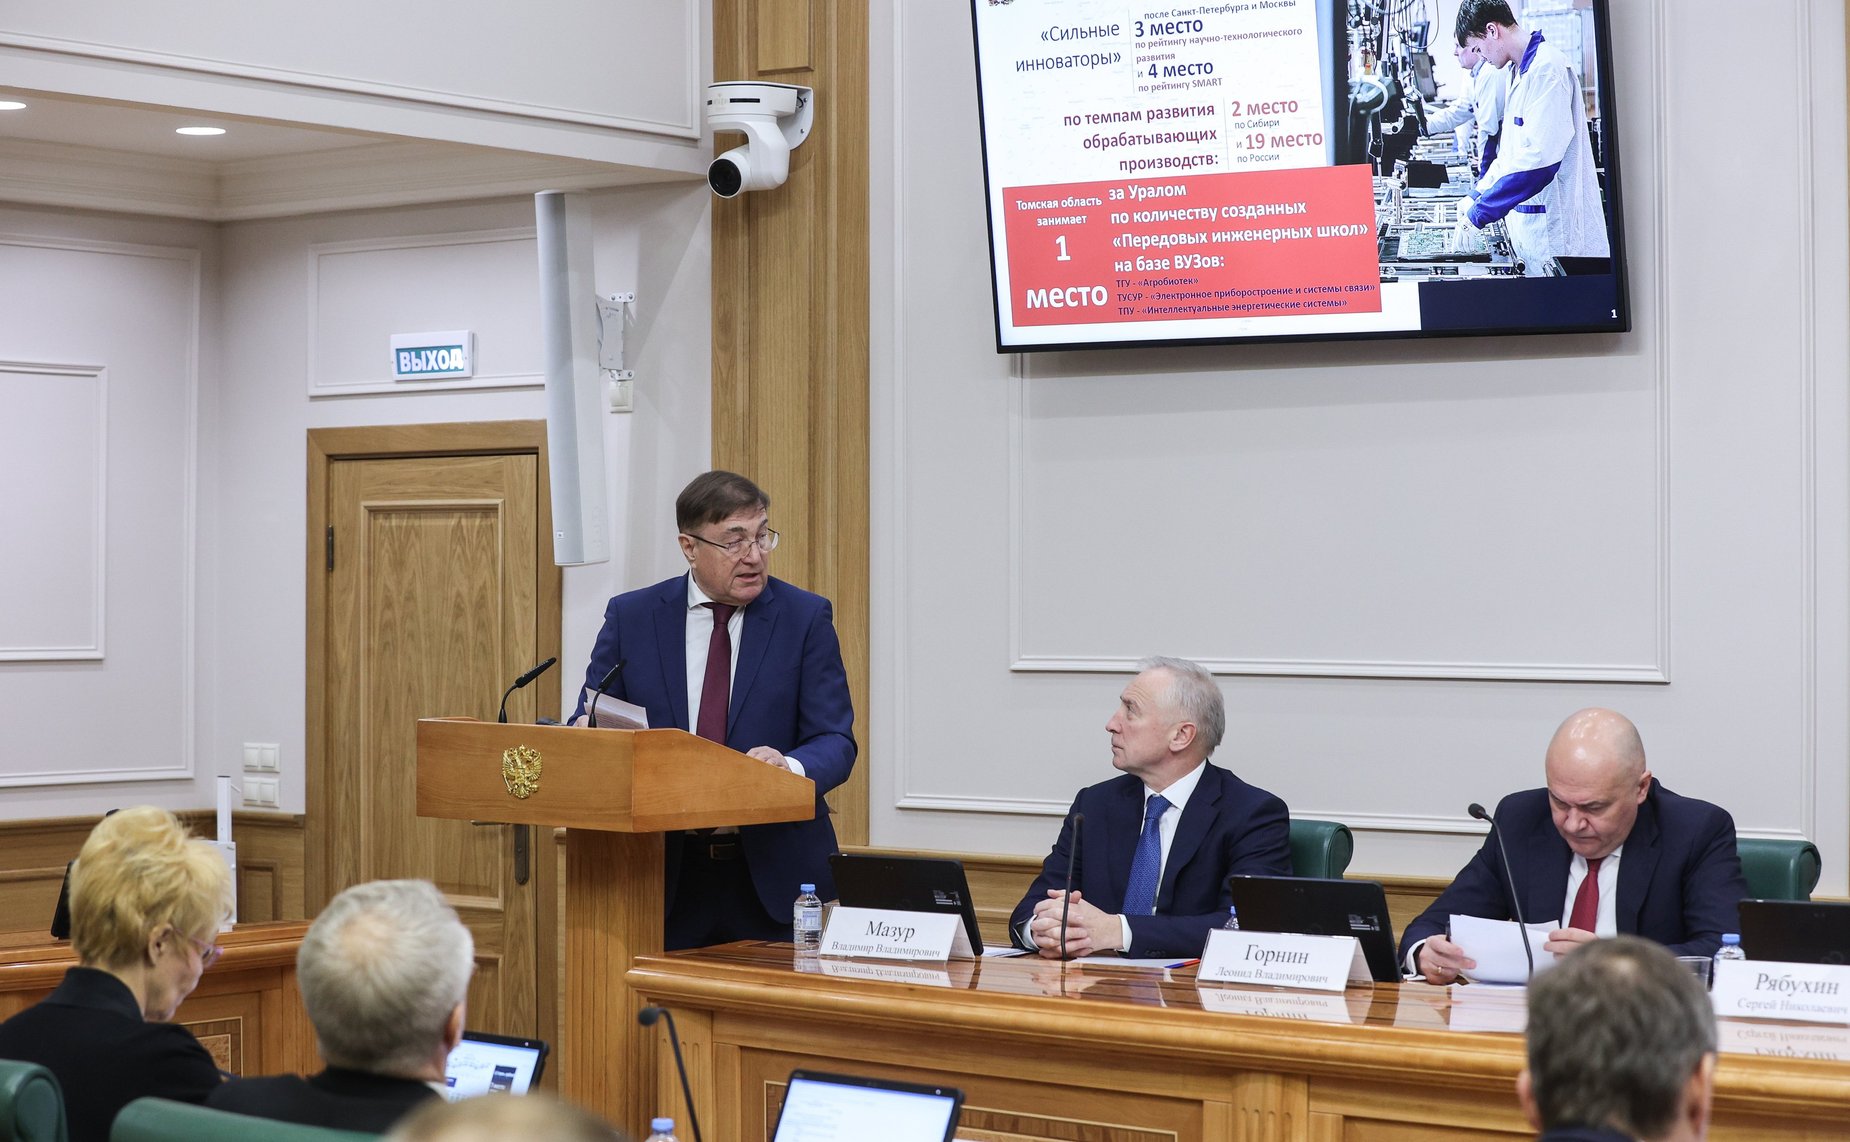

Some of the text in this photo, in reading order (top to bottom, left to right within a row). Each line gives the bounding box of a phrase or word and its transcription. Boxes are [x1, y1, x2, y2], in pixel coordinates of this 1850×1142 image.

[1144, 11, 1169, 20] после
[1171, 3, 1249, 18] Санкт-Петербурга
[1259, 0, 1296, 9] Москвы
[1040, 23, 1120, 42] «Сильные
[1134, 19, 1203, 38] 3 место
[1135, 28, 1303, 50] по рейтингу научно-технологического
[1016, 51, 1121, 72] инноваторы»
[1136, 53, 1176, 64] развития
[1148, 63, 1158, 78] 4
[1163, 62, 1214, 78] место
[1138, 78, 1223, 93] по рейтингу SMART
[1064, 105, 1215, 127] по темпам развития
[1232, 100, 1298, 117] 2 место
[1247, 118, 1280, 129] Сибири
[1083, 129, 1217, 151] обрабатывающих
[1246, 133, 1265, 150] 19
[1271, 133, 1323, 148] место
[1119, 154, 1219, 173] производств:
[1250, 154, 1280, 162] России
[1108, 184, 1187, 201] за Уралом
[1016, 196, 1103, 211] Томская область
[1037, 215, 1087, 227] занимает
[1110, 202, 1307, 224] по количеству созданных
[1113, 224, 1368, 249] «Передовых инженерных школ»
[1055, 235, 1071, 261] 1
[1115, 254, 1225, 272] на базе ВУЗов:
[1116, 280, 1131, 288] ТГУ
[1138, 277, 1199, 288] «Агробиотек»
[1026, 285, 1108, 309] место
[1117, 293, 1143, 302] ТУСУР
[1151, 291, 1212, 301] «Электронное
[1214, 287, 1293, 299] приборостроение
[1303, 285, 1342, 294] системы
[1344, 284, 1376, 292] связи»
[1118, 307, 1135, 316] ТПУ
[1142, 303, 1230, 315] «Интеллектуальные
[1231, 301, 1301, 313] энергетические
[1303, 299, 1348, 308] системы»
[1611, 309, 1618, 319] 1
[400, 348, 464, 372] ВЫХОД
[865, 920, 915, 942] Мазур
[831, 941, 940, 958] Владимир Владимирович
[1244, 944, 1310, 967] Горнин
[1215, 967, 1329, 984] Леонид Владимирович
[1754, 973, 1840, 997] Рябухин
